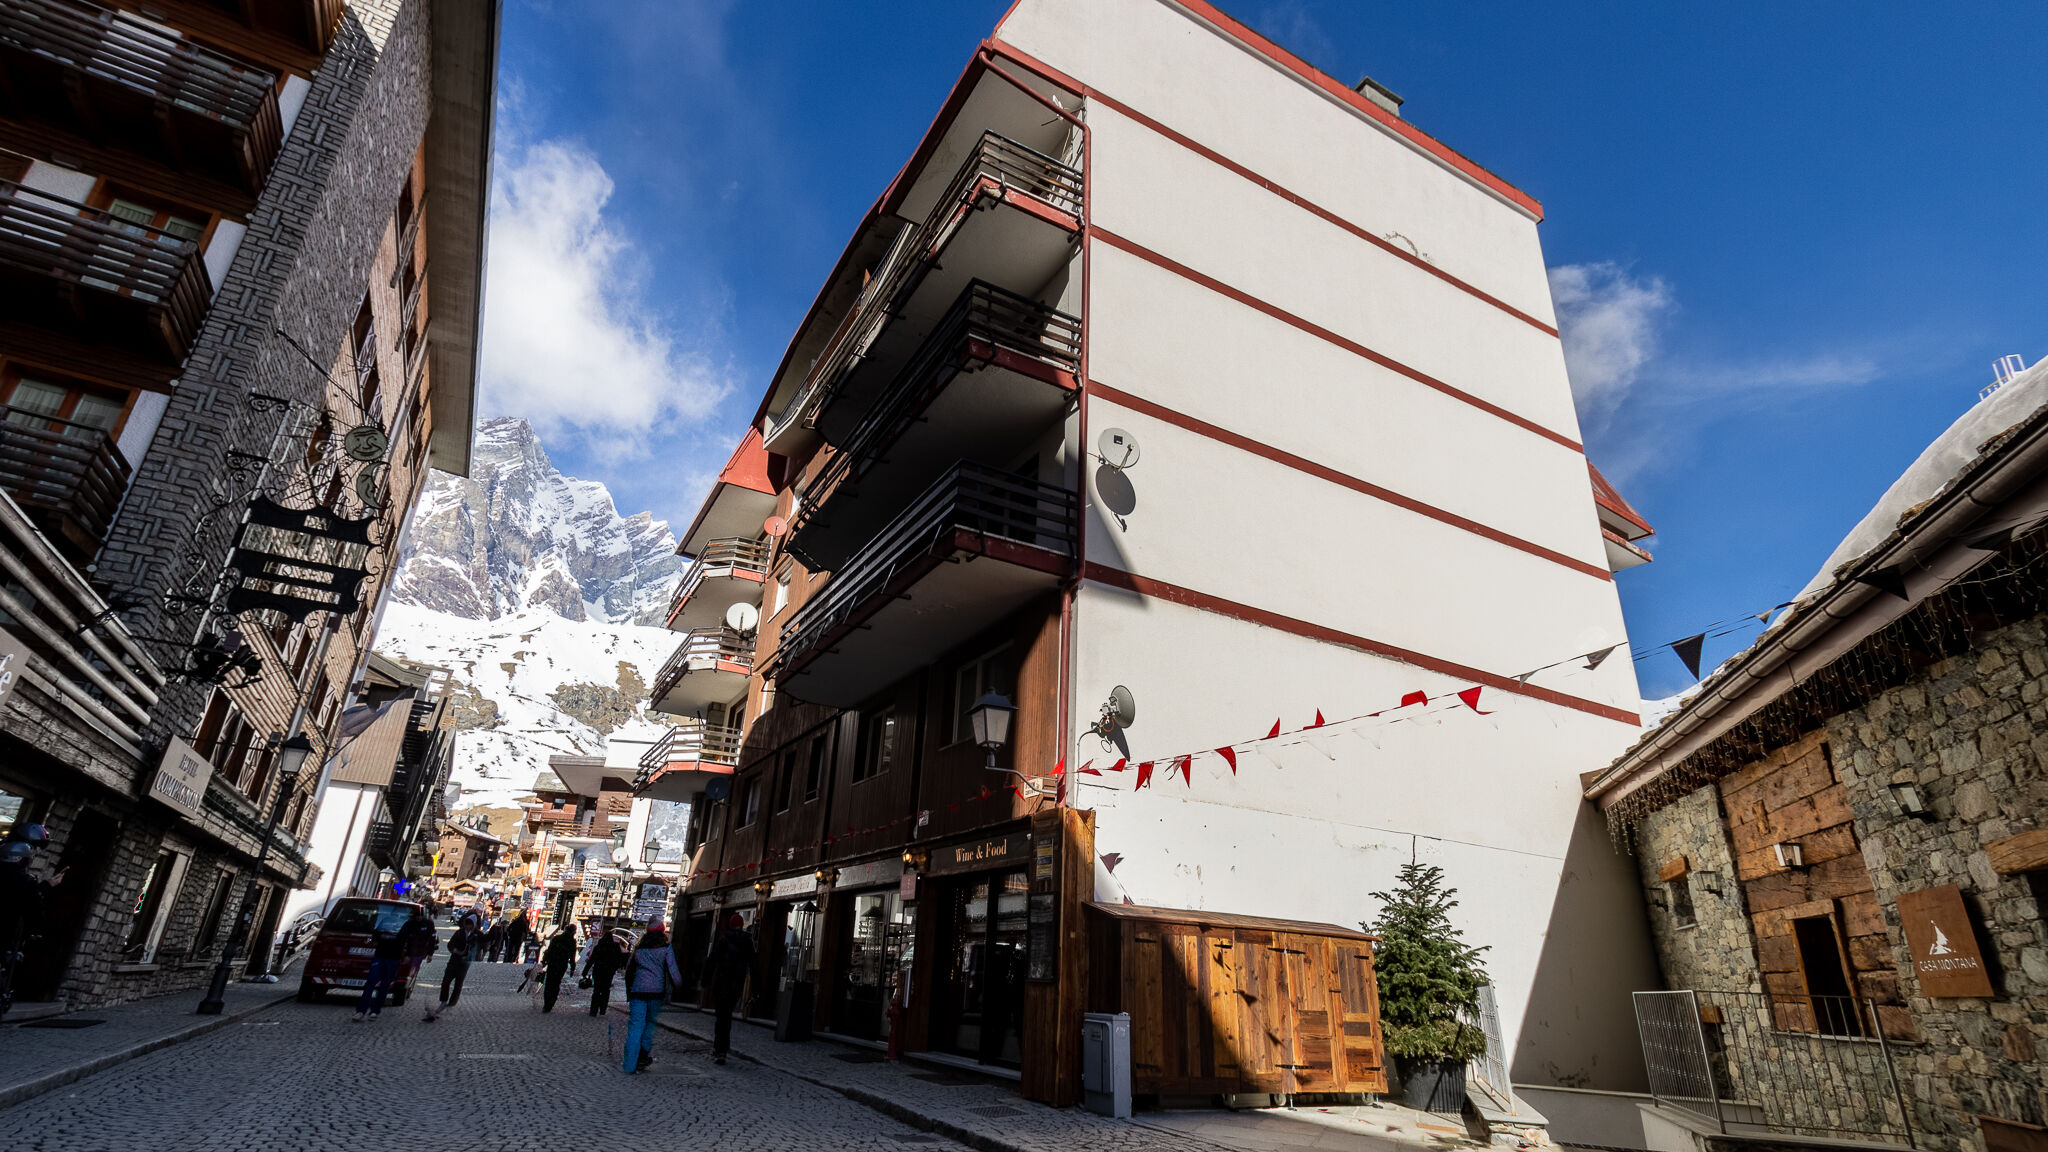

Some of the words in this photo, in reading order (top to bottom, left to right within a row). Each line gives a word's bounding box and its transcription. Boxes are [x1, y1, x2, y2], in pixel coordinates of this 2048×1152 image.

[179, 754, 199, 778] HOTEL
[955, 847, 975, 863] Wine
[975, 844, 984, 860] &
[985, 838, 1008, 858] Food
[1919, 960, 1938, 972] CASA
[1937, 956, 1979, 971] MONTANA
